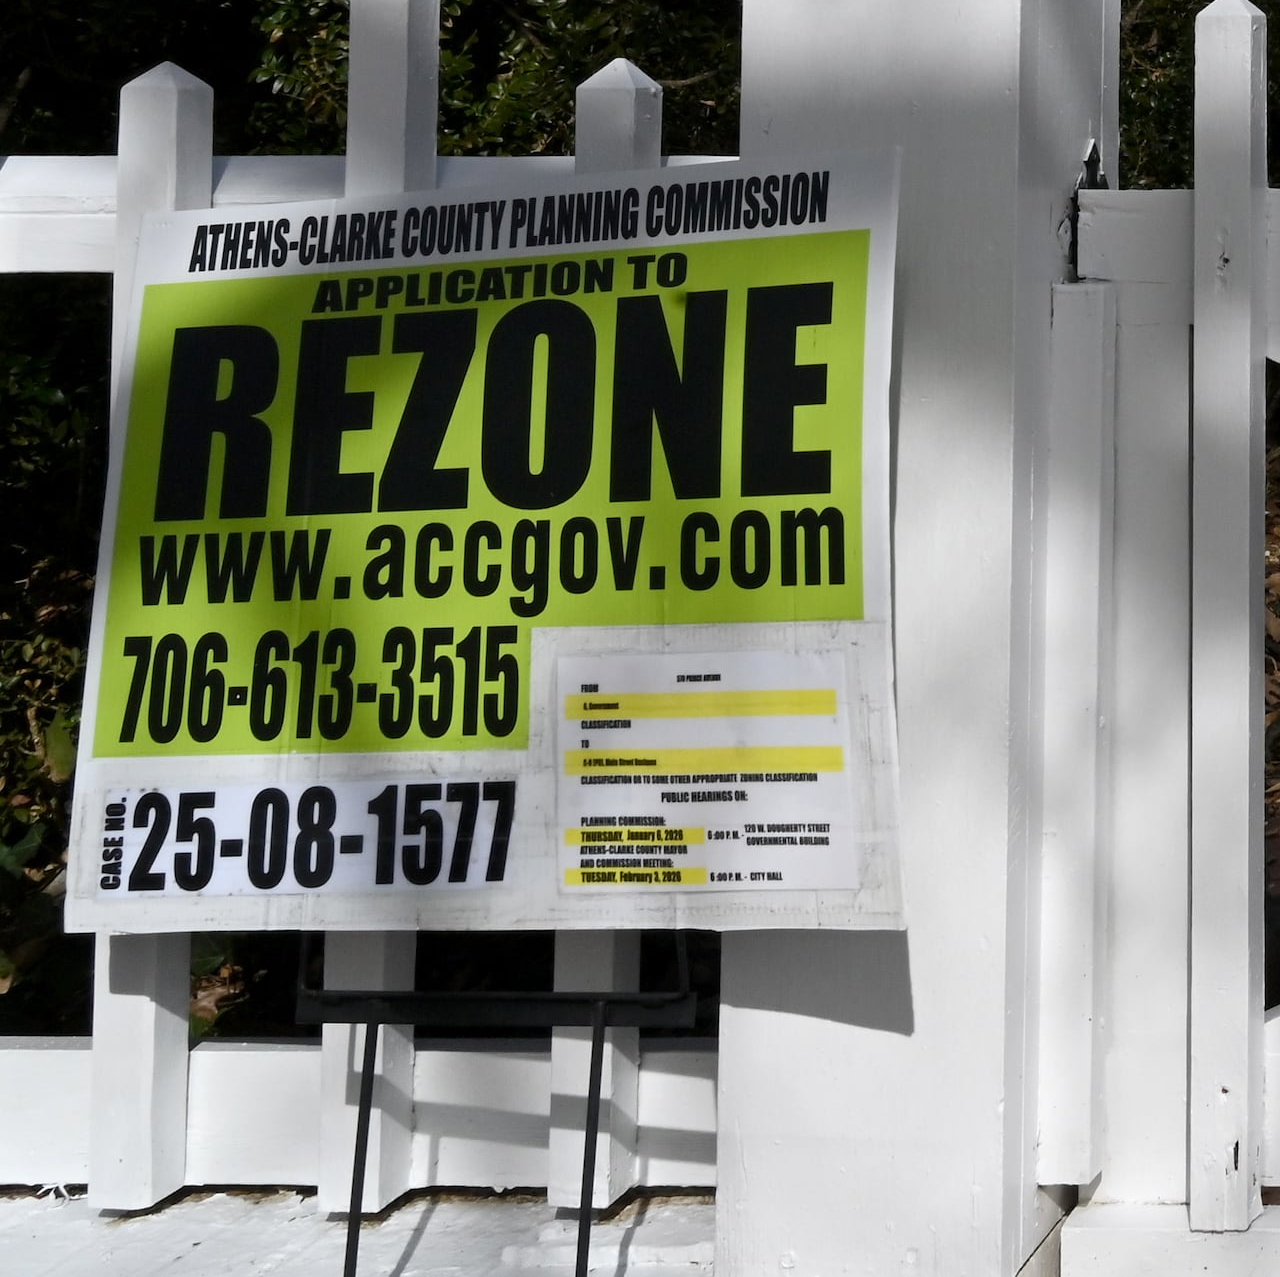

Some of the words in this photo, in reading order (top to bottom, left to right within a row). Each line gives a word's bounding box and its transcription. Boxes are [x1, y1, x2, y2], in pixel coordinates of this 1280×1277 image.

[188, 210, 398, 273] ATHENS-CLARKE
[401, 200, 506, 258] COUNTY
[509, 187, 640, 248] PLANNING
[645, 170, 830, 238] COMMISSION
[311, 257, 615, 314] APPLICATION
[627, 252, 689, 289] TO
[153, 281, 834, 523] REZONE
[139, 507, 846, 617] www.accgov.com
[118, 625, 519, 745] 706-613-3515
[581, 684, 598, 692] FROM
[581, 720, 631, 729] CLASSIFICATION
[581, 740, 589, 748] TO
[581, 776, 632, 784] CLASSIFICATION
[633, 776, 642, 784] OR
[643, 776, 651, 784] TO
[652, 775, 669, 784] SOME
[670, 775, 691, 784] OTHER
[692, 774, 738, 783] APPROPRIATE
[740, 773, 764, 782] ZONING
[765, 772, 818, 782] CLASSIFICATION
[661, 791, 689, 803] PUBLIC
[691, 790, 733, 803] HEARINGS
[734, 790, 748, 802] ON:
[104, 797, 127, 831] NO.
[581, 817, 616, 827] PLANNING
[618, 816, 666, 826] COMMISSION:
[744, 824, 756, 833] 120
[757, 824, 766, 832] W.
[767, 823, 806, 832] DOUGHERTY
[807, 823, 830, 832] STREET
[128, 781, 516, 891] 25-08-1577
[581, 831, 623, 843] THURSDAY,
[627, 829, 655, 842] January
[664, 829, 683, 841] 2026
[746, 836, 798, 845] GOVERNMENTAL
[799, 836, 829, 845] BUILDING
[580, 845, 634, 855] ATHENS-CLARKE
[636, 845, 661, 854] COUNTY
[663, 845, 688, 854] MAYOR
[100, 836, 124, 890] CASE
[580, 859, 595, 868] AND
[596, 858, 641, 868] COMMISSION
[642, 858, 674, 868] MEETING:
[581, 871, 617, 883] TUESDAY,
[619, 871, 653, 884] February
[662, 871, 682, 882] 2026
[750, 872, 766, 881] CITY
[766, 871, 783, 881] HALL
